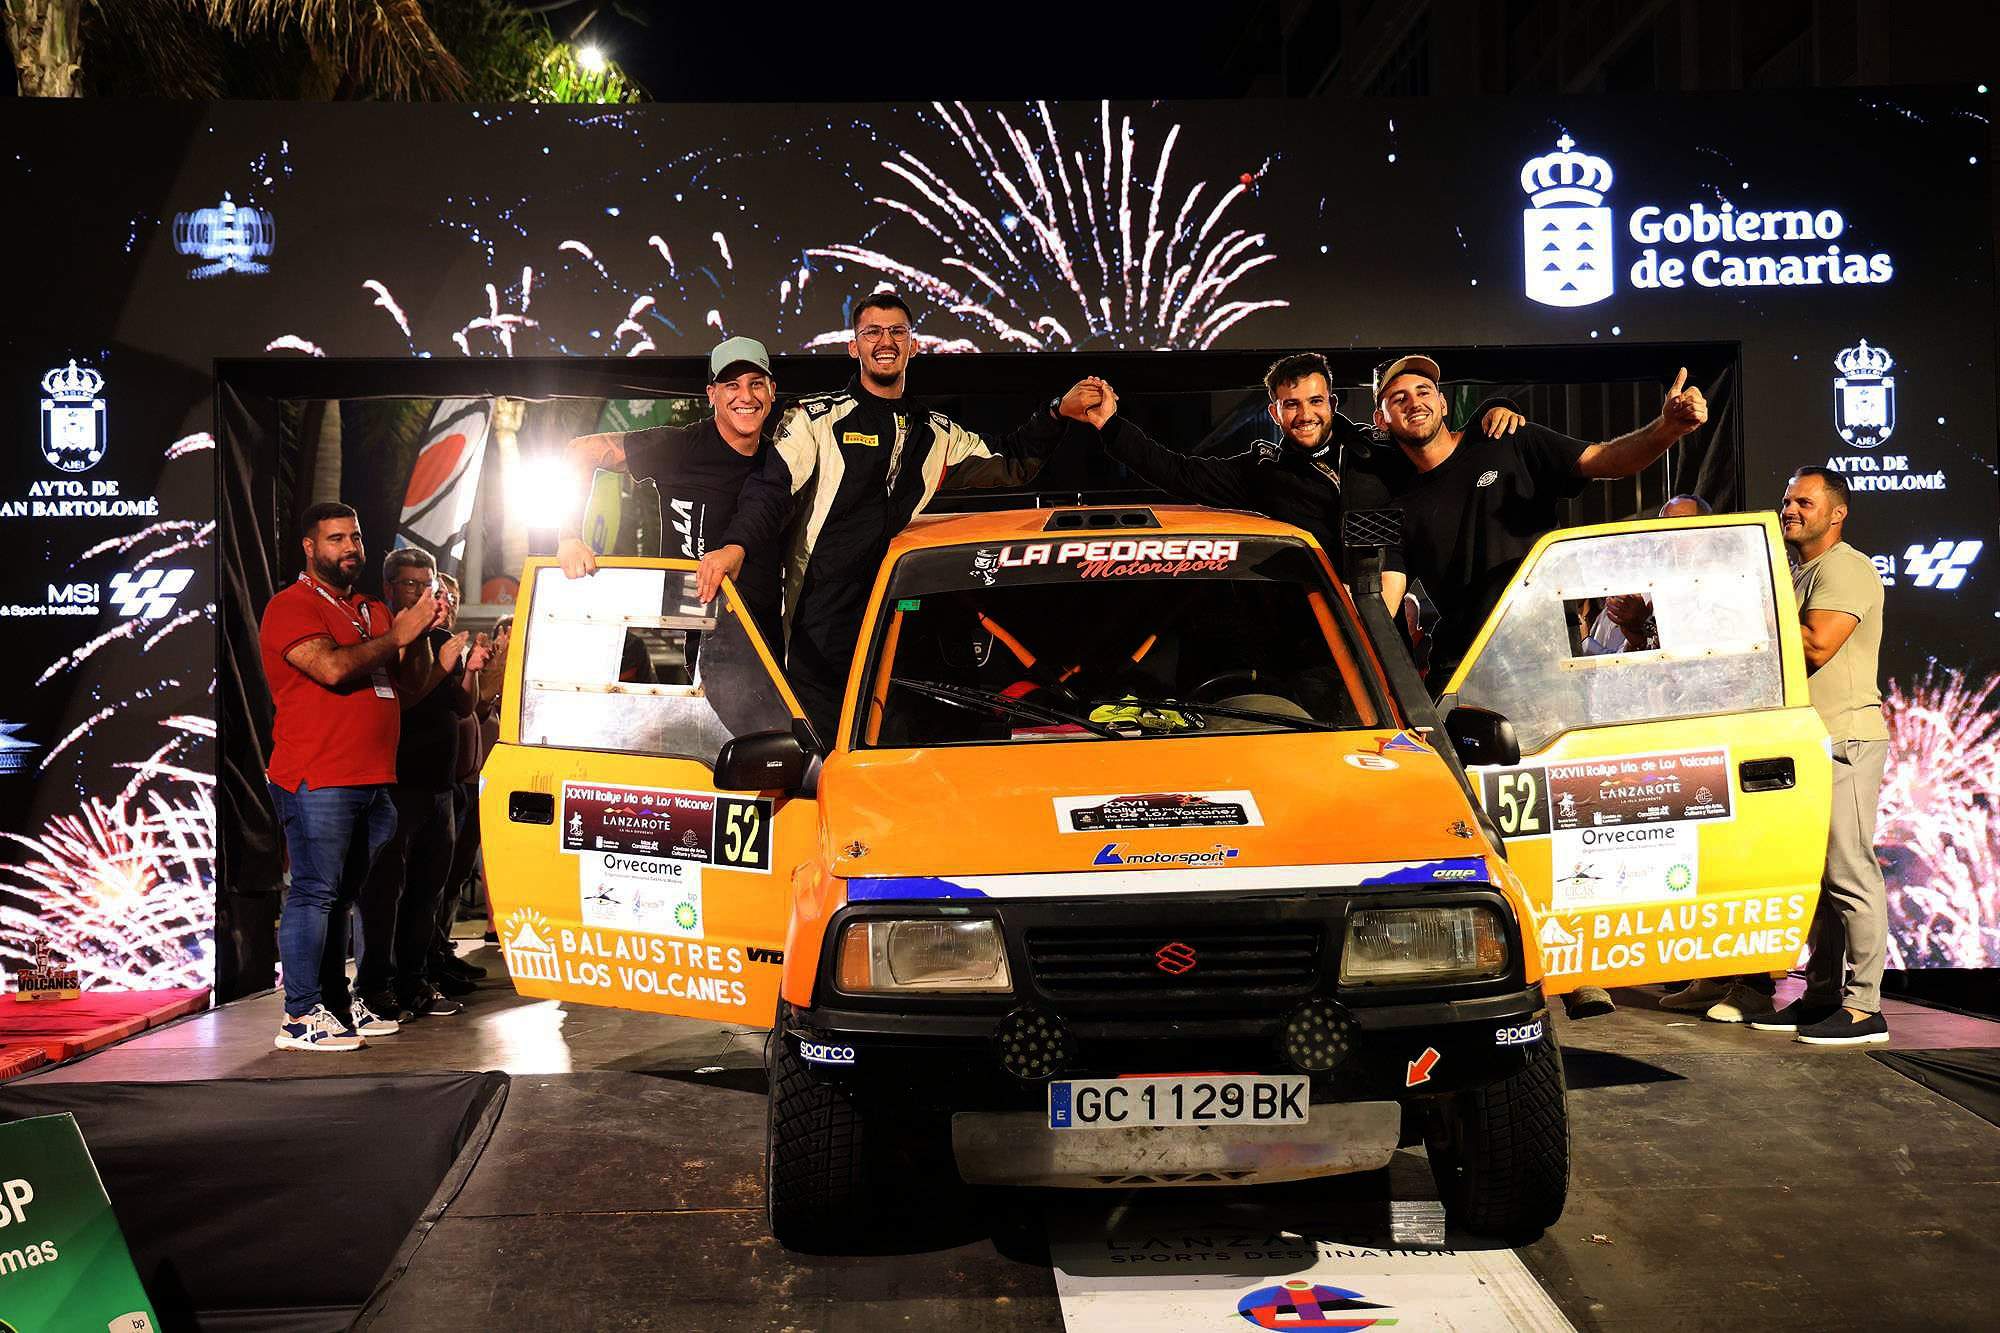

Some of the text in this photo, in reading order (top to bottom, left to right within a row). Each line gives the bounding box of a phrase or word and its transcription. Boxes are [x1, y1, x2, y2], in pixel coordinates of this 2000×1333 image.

[1629, 203, 1844, 243] Gobierno
[1630, 245, 1893, 288] de Canarias
[1826, 455, 1910, 473] AYTO. DE
[28, 481, 120, 497] AYTO. DE
[0, 496, 159, 517] AN BARTOLOMÉ
[1000, 540, 1240, 568] LA PEDRERA
[1077, 556, 1229, 579] Motorsport
[48, 605, 100, 616] Institute
[1549, 754, 1724, 780] XXVII Rallye Isla de Los Volcanes
[566, 787, 714, 811] XXVII Rallye Isla de Los Volcanes
[1498, 772, 1540, 833] 52
[1599, 783, 1681, 800] LANZAROTE
[1103, 800, 1149, 808] XXVII
[603, 815, 671, 831] LANZAROTE
[725, 804, 761, 864] 52
[1581, 827, 1676, 845] Orvecame
[604, 853, 683, 876] Orvecame
[1127, 850, 1225, 865] motorsport
[1593, 895, 1806, 939] BALAUSTRES
[561, 929, 744, 974] BALAUSTRES
[1591, 927, 1801, 971] LOS VOLCANES
[18, 976, 79, 993] VOLCANES
[565, 960, 747, 1006] LOS VOLCANES
[1495, 1020, 1543, 1045] sparco
[800, 1041, 855, 1060] sparco
[1056, 1110, 1066, 1121] E
[1109, 1249, 1457, 1264] SPORTS DESTINATION
[132, 1319, 145, 1330] bp
